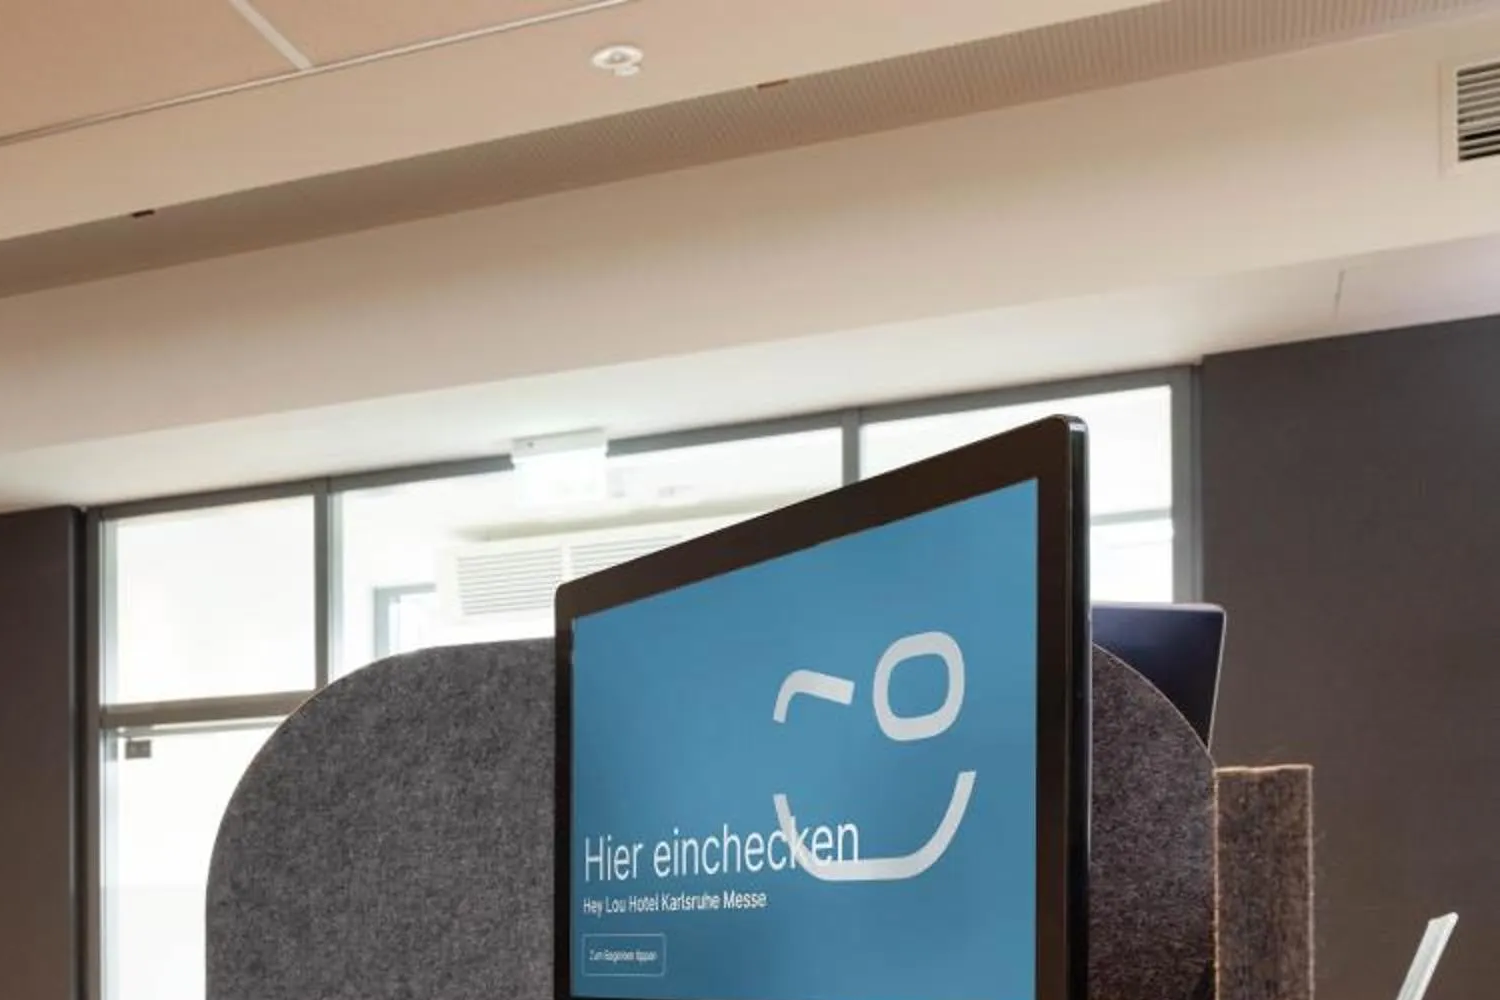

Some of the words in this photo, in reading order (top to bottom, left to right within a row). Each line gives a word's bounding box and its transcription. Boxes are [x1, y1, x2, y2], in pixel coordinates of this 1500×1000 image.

[584, 834, 644, 882] Hier
[653, 816, 860, 878] einchecken
[583, 896, 602, 918] Hey
[605, 896, 627, 913] Lou
[628, 893, 660, 912] Hotel
[661, 891, 721, 911] Karlsruhe
[723, 889, 768, 909] Messe
